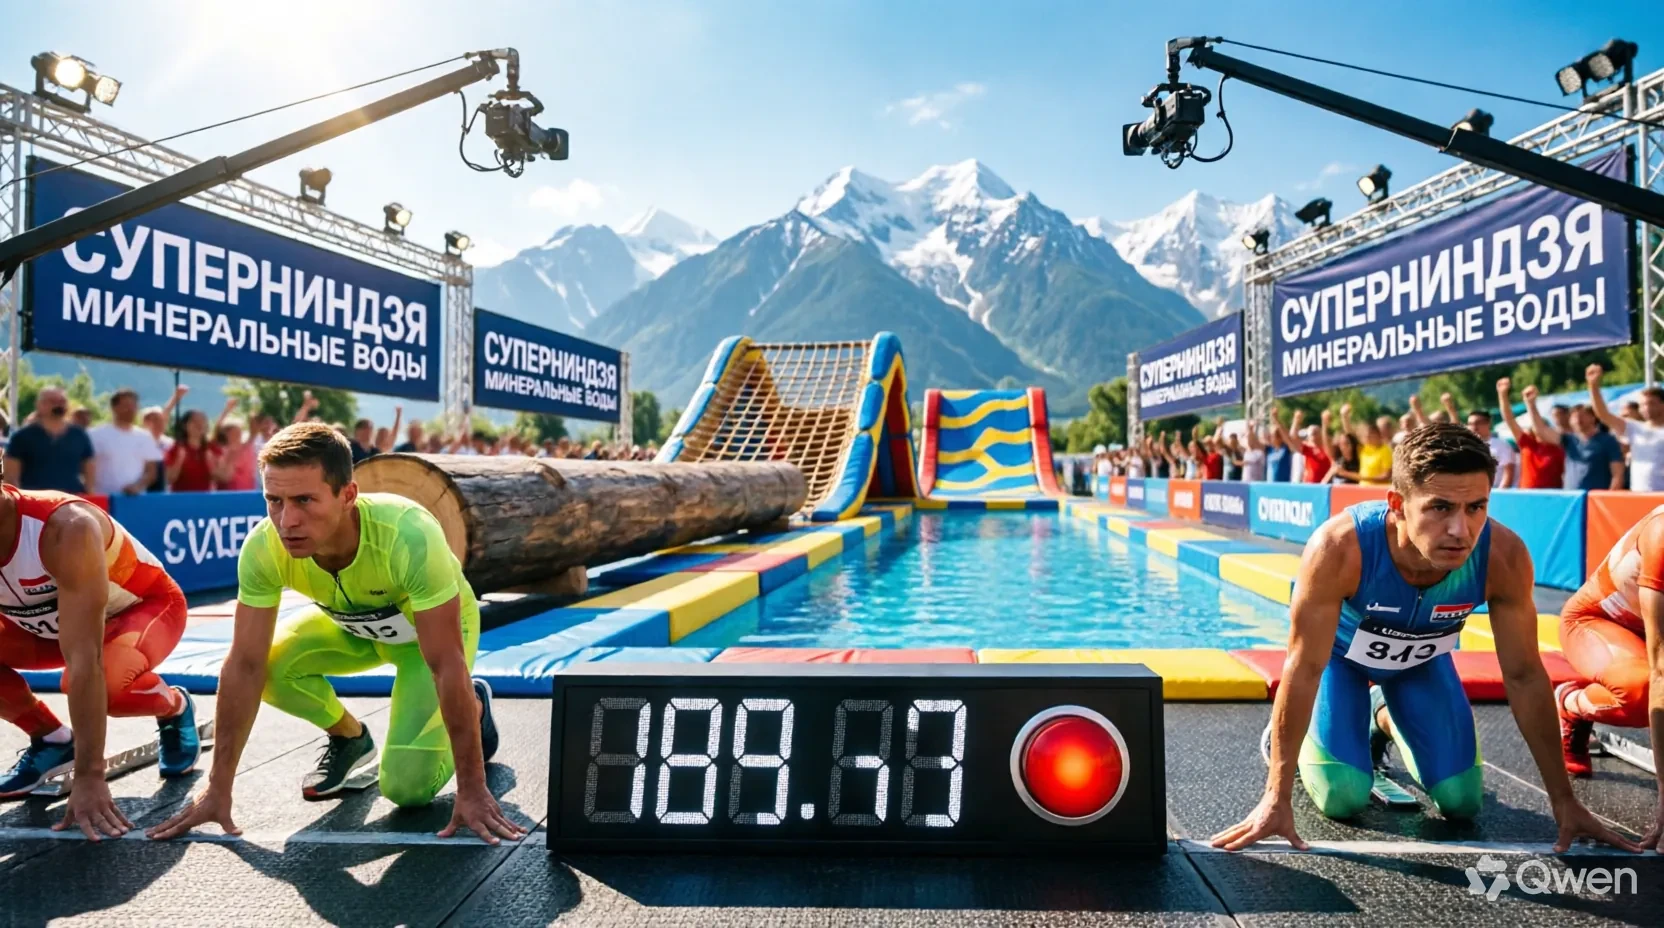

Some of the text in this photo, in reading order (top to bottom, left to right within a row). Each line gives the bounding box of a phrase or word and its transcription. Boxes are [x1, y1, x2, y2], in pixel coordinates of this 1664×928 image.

[61, 207, 427, 347] СУПЕРНИНДЗЯ
[1280, 201, 1604, 343] СУПЕРНИНДЗЯ
[62, 283, 427, 381] МИНЕРАЛЬНЫЕ ВОДЫ
[484, 331, 617, 390] СУПЕРНИНДЗЯ
[1282, 277, 1606, 377] МИНЕРАЛЬНЫЕ ВОДЫ
[485, 369, 583, 405] МИНЕРАЛЬНЫЕ
